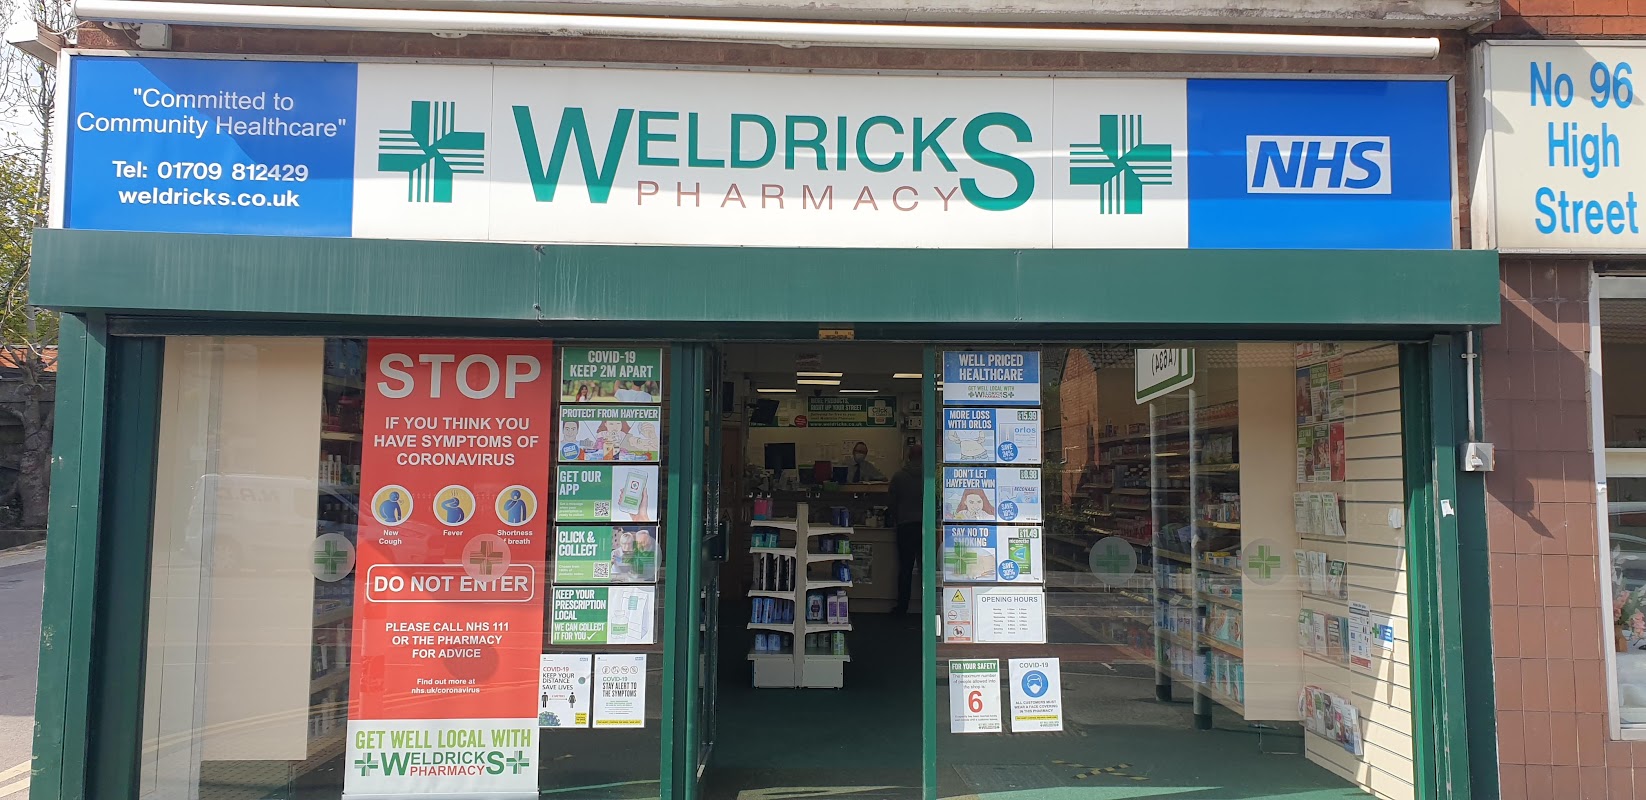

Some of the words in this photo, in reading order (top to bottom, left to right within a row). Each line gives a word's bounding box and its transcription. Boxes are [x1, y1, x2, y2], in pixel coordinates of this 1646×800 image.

[1530, 61, 1574, 108] No
[1590, 61, 1634, 109] 96
[133, 88, 265, 111] "Committed
[273, 92, 294, 111] to
[77, 112, 208, 139] Community
[216, 116, 347, 138] Healthcare"
[1548, 122, 1620, 178] High
[1251, 141, 1384, 189] NHS
[112, 161, 147, 178] Tel:
[157, 161, 222, 180] 01709
[232, 163, 308, 182] 812429
[118, 187, 300, 207] weldricks.co.uk
[637, 180, 960, 212] PHARMACY
[1534, 187, 1639, 234] Street
[588, 350, 636, 363] COVID-19
[959, 354, 985, 366] WELL
[988, 354, 1023, 366] PRICED
[377, 353, 541, 399] STOP
[570, 365, 597, 377] KEEP
[600, 365, 616, 377] 2M
[619, 365, 653, 377] APART
[960, 368, 1023, 381] HEALTHCARE
[562, 408, 596, 418] PROTECT
[597, 409, 619, 418] FROM
[620, 409, 658, 418] HAYFEVER
[950, 410, 970, 419] MORE
[971, 411, 990, 420] LOSS
[385, 417, 399, 430] IF
[404, 417, 437, 430] YOU
[443, 417, 491, 430] THINK
[495, 418, 530, 431] YOU
[948, 420, 967, 428] WITH
[968, 420, 992, 428] ORLOS
[1014, 426, 1036, 434] orlos
[374, 435, 417, 447] HAVE
[421, 435, 512, 448] SYMPTOMS
[517, 436, 539, 448] OF
[397, 453, 515, 466] CORONAVIRUS
[560, 471, 579, 482] GET
[581, 471, 602, 482] OUR
[954, 470, 974, 478] DON'T
[975, 470, 988, 478] LET
[946, 479, 980, 488] HAYFEVER
[982, 479, 995, 488] WIN
[559, 484, 579, 496] APP
[559, 531, 586, 543] CLICK
[587, 531, 595, 543] &
[952, 528, 966, 537] SAY
[968, 528, 978, 537] NO
[980, 528, 988, 537] TO
[559, 544, 598, 556] COLLECT
[374, 576, 404, 592] DO
[410, 576, 454, 592] NOT
[459, 576, 529, 592] ENTER
[555, 590, 574, 600] KEEP
[576, 590, 595, 600] YOUR
[555, 600, 606, 610] PRESCRIPTION
[555, 610, 578, 620] LOCAL
[385, 622, 430, 632] PLEASE
[433, 622, 464, 632] CALL
[466, 622, 490, 631] NHS
[492, 622, 509, 631] 111
[554, 622, 564, 632] WE
[566, 622, 578, 632] CAN
[579, 622, 606, 632] COLLECT
[392, 636, 409, 645] OR
[412, 636, 434, 645] THE
[437, 635, 503, 645] PHARMACY
[554, 632, 560, 640] IT
[561, 632, 573, 640] FOR
[574, 632, 587, 640] YOU
[412, 649, 436, 658] FOR
[438, 649, 481, 658] ADVICE
[411, 686, 480, 694] nhs.uk/coronavirus
[968, 690, 983, 713] 6
[355, 730, 386, 749] GET
[390, 730, 432, 749] WELL
[438, 730, 486, 748] LOCAL
[491, 729, 531, 748] WITH
[410, 766, 485, 776] PHARMACY
